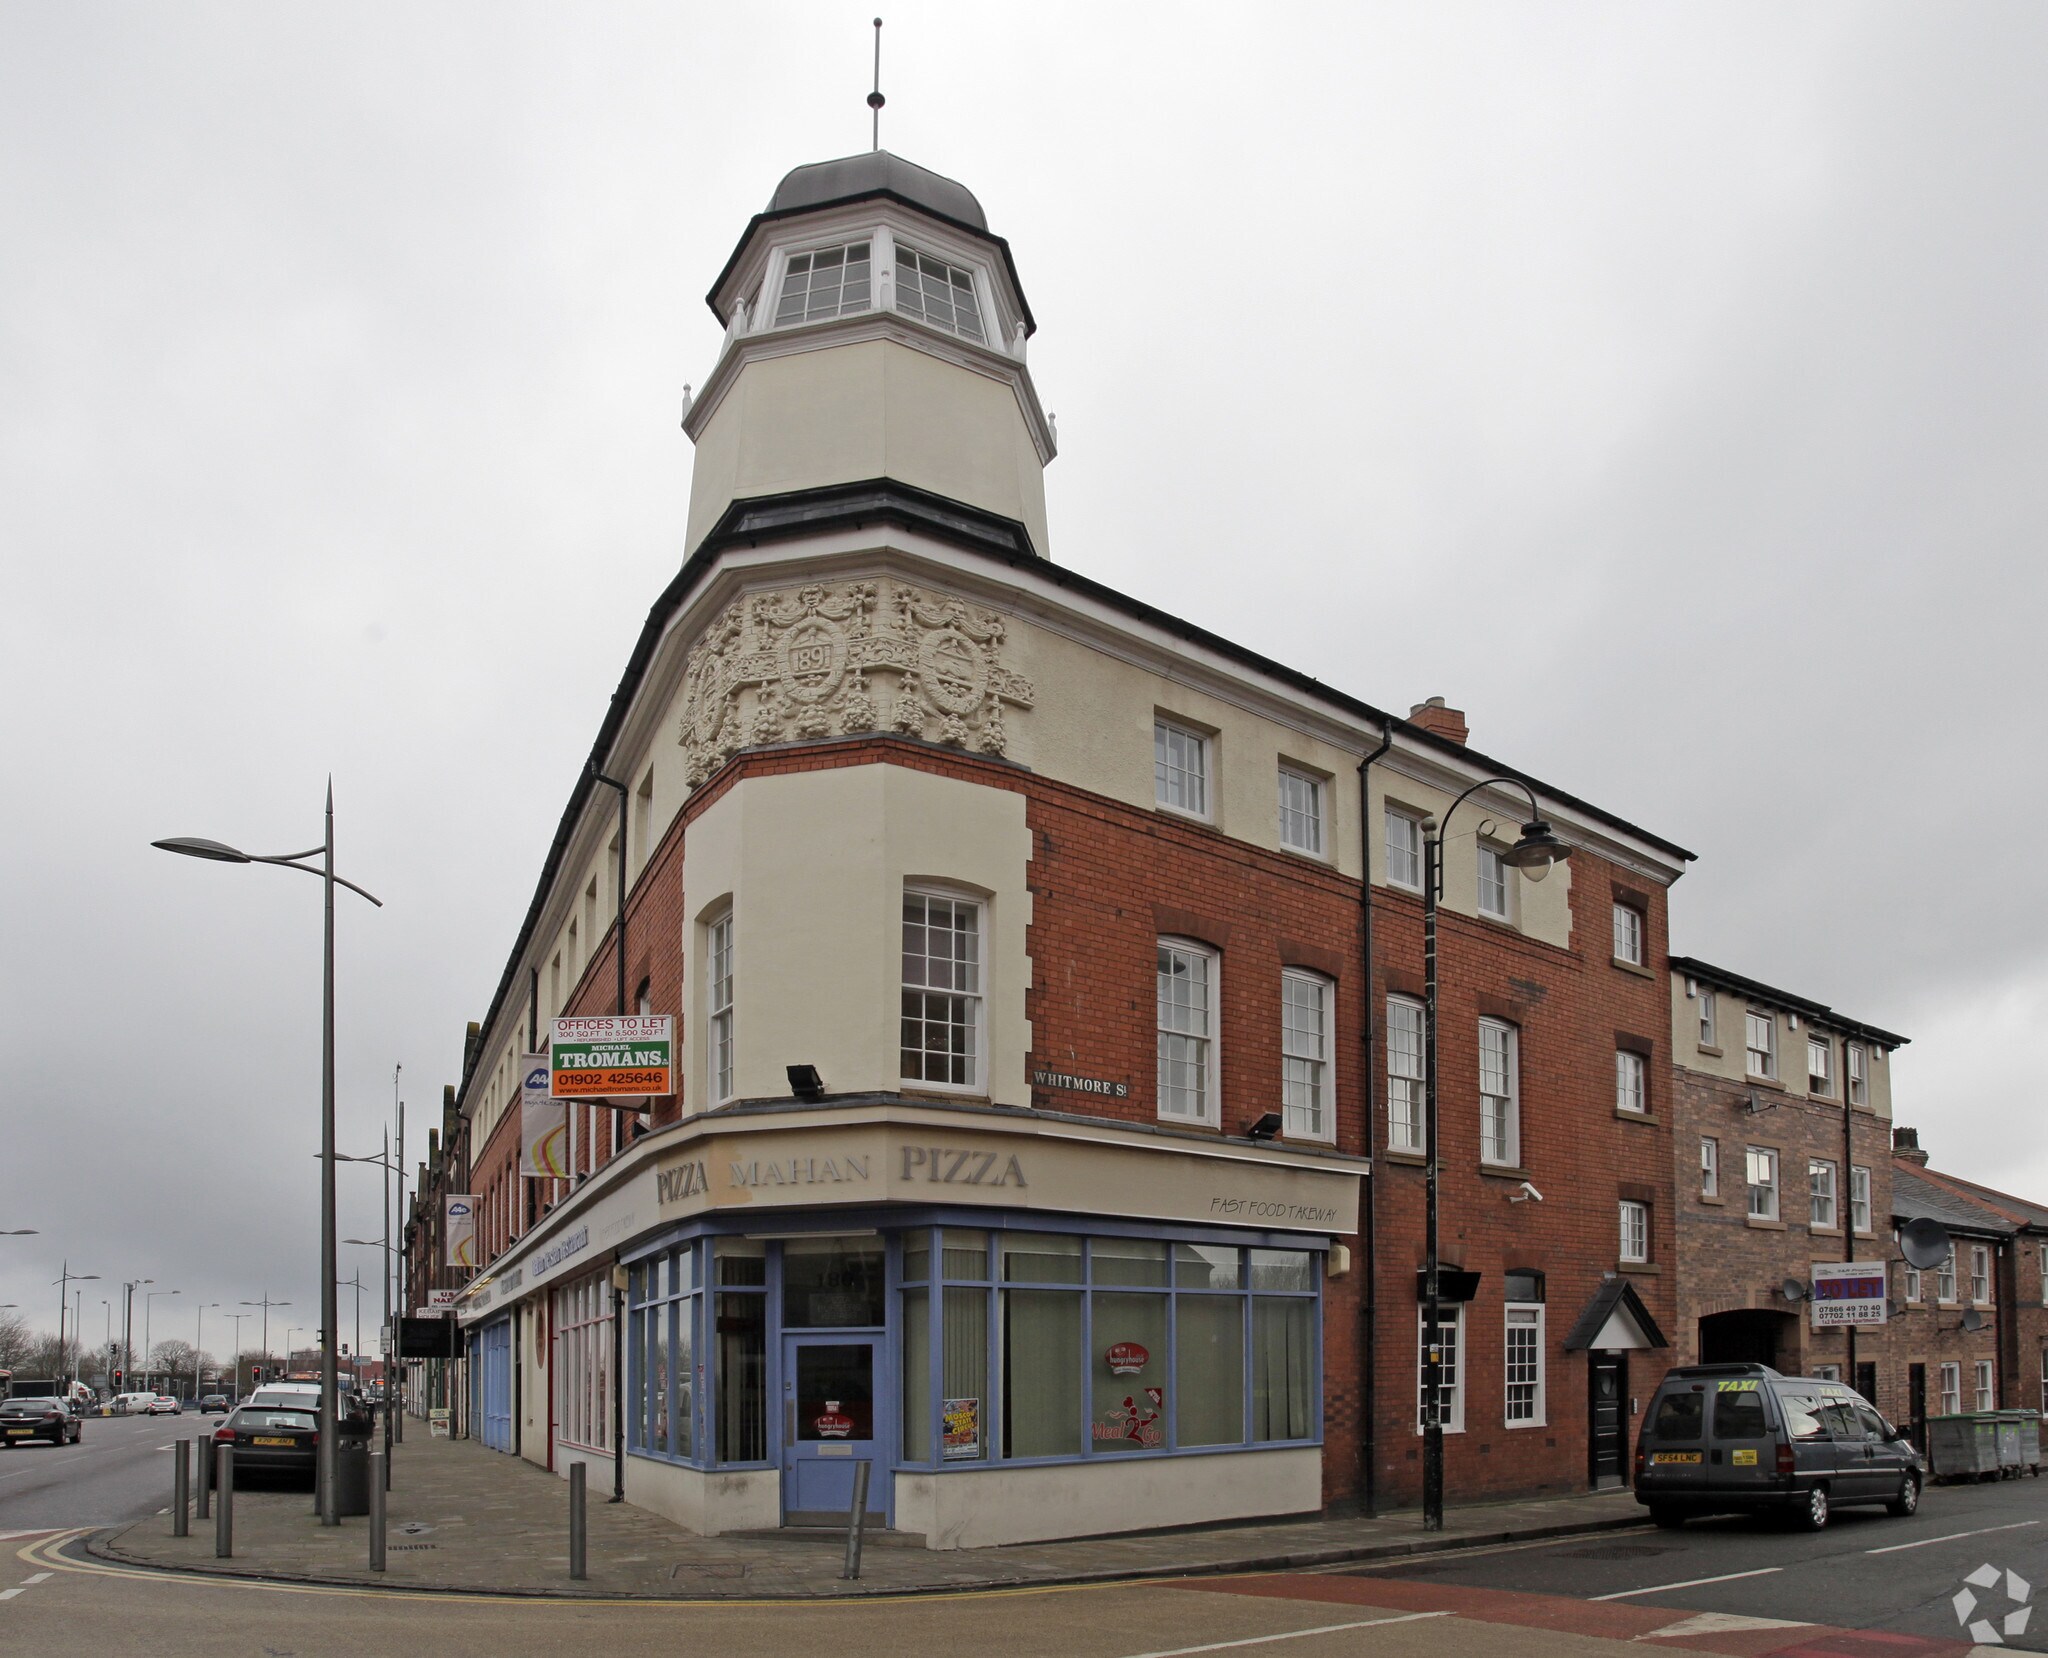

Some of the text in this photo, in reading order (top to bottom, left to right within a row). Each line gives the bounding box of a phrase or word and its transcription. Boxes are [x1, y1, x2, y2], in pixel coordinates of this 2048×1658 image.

[793, 646, 831, 673] 1891
[558, 1018, 666, 1030] OFFICES TO LET
[560, 1050, 662, 1068] TROMANS
[558, 1072, 663, 1085] 01902 425646
[1033, 1071, 1111, 1095] WHITMORE
[729, 1155, 870, 1188] MAHAN
[901, 1145, 1029, 1188] PIZZA
[656, 1159, 709, 1206] PIZZA
[1210, 1198, 1338, 1222] FAST FOOD TAKEWAY
[1820, 1278, 1880, 1299] TO LET
[1818, 1312, 1844, 1320] 07702
[1109, 1348, 1145, 1365] hungryhouse
[1717, 1380, 1759, 1392] TAXI
[1819, 1387, 1843, 1397] TAXI
[817, 1418, 850, 1430] hungryhouse
[945, 1410, 975, 1423] MOSCOW
[1657, 1454, 1697, 1462] SF54 LNC
